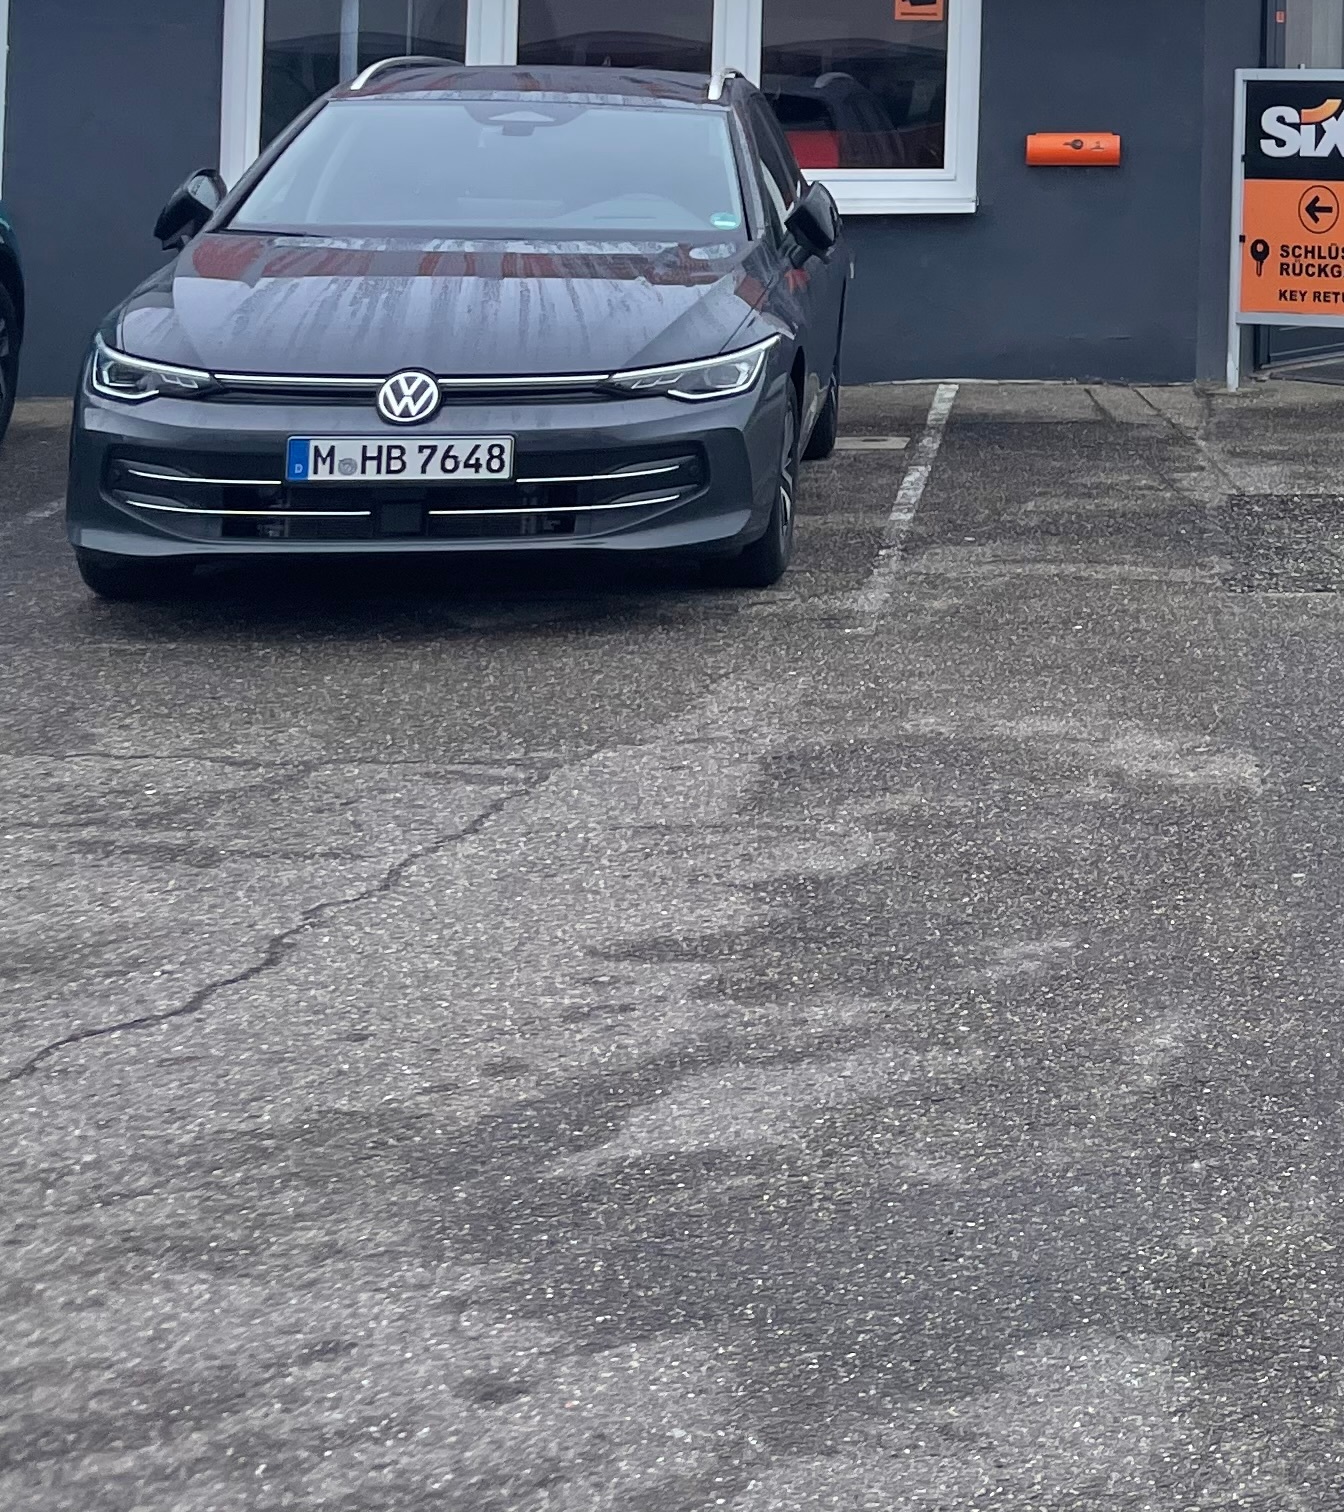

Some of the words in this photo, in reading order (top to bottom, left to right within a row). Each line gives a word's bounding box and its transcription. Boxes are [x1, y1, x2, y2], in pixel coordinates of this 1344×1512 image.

[1278, 289, 1307, 302] KEY
[313, 445, 336, 475] M
[360, 445, 406, 475] HB
[418, 443, 506, 475] 7648
